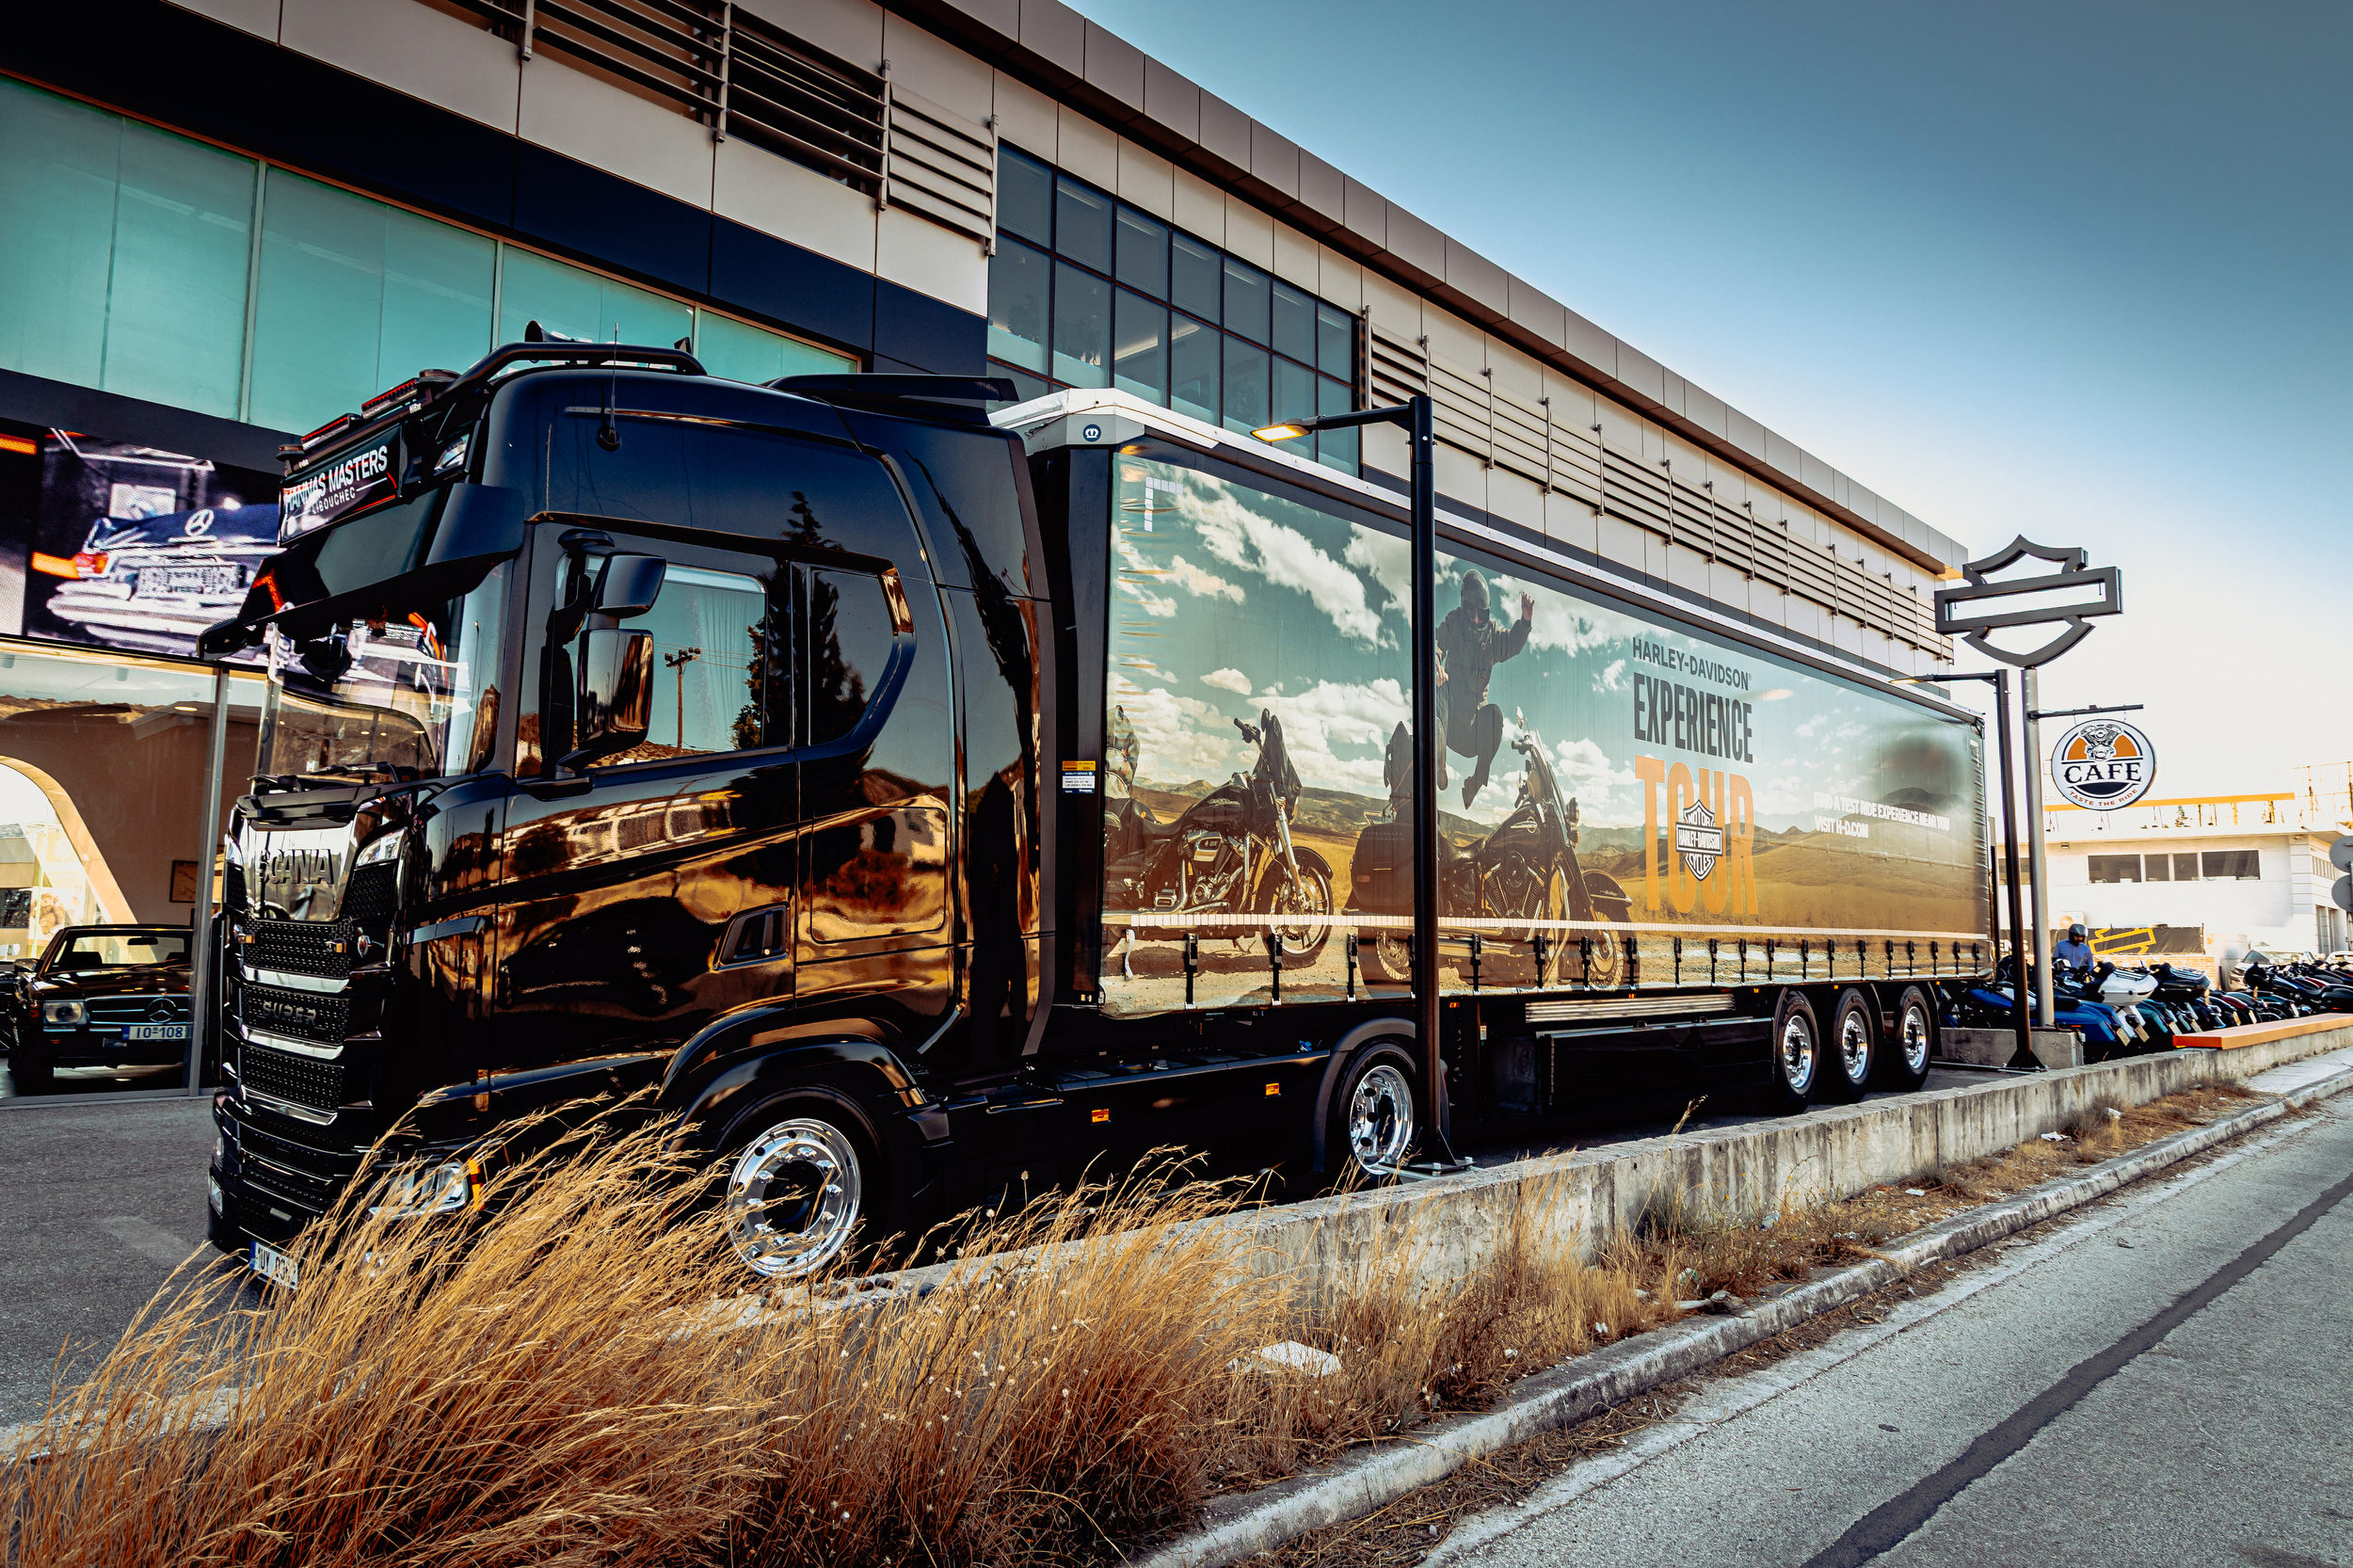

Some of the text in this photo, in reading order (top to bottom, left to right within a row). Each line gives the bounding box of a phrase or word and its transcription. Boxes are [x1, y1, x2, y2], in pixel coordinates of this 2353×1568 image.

[328, 445, 388, 493] MASTERS
[311, 487, 356, 515] LIBOUCHEC
[1632, 636, 1749, 691] HARLEY-DAVIDSON
[1633, 671, 1753, 763] EXPERIENCE
[2063, 761, 2142, 784] CAFE
[2069, 791, 2095, 806] TASTE
[2118, 789, 2138, 803] RIDE
[1688, 808, 1711, 827] MOTOR
[1814, 815, 1835, 834] VISIT
[1833, 794, 1841, 810] A
[1840, 795, 1860, 815] TEST
[1860, 799, 1878, 818] RIDE
[1877, 803, 1919, 825] EXPERIENCE
[1919, 811, 1937, 829] NEAR
[1936, 815, 1950, 832] YOU
[1635, 755, 1759, 915] TOUR
[1678, 829, 1721, 850] HARLEY-DAVIDSON
[260, 848, 335, 885] SCANIA
[1689, 853, 1713, 875] CYCLES
[262, 1000, 317, 1027] SUPER
